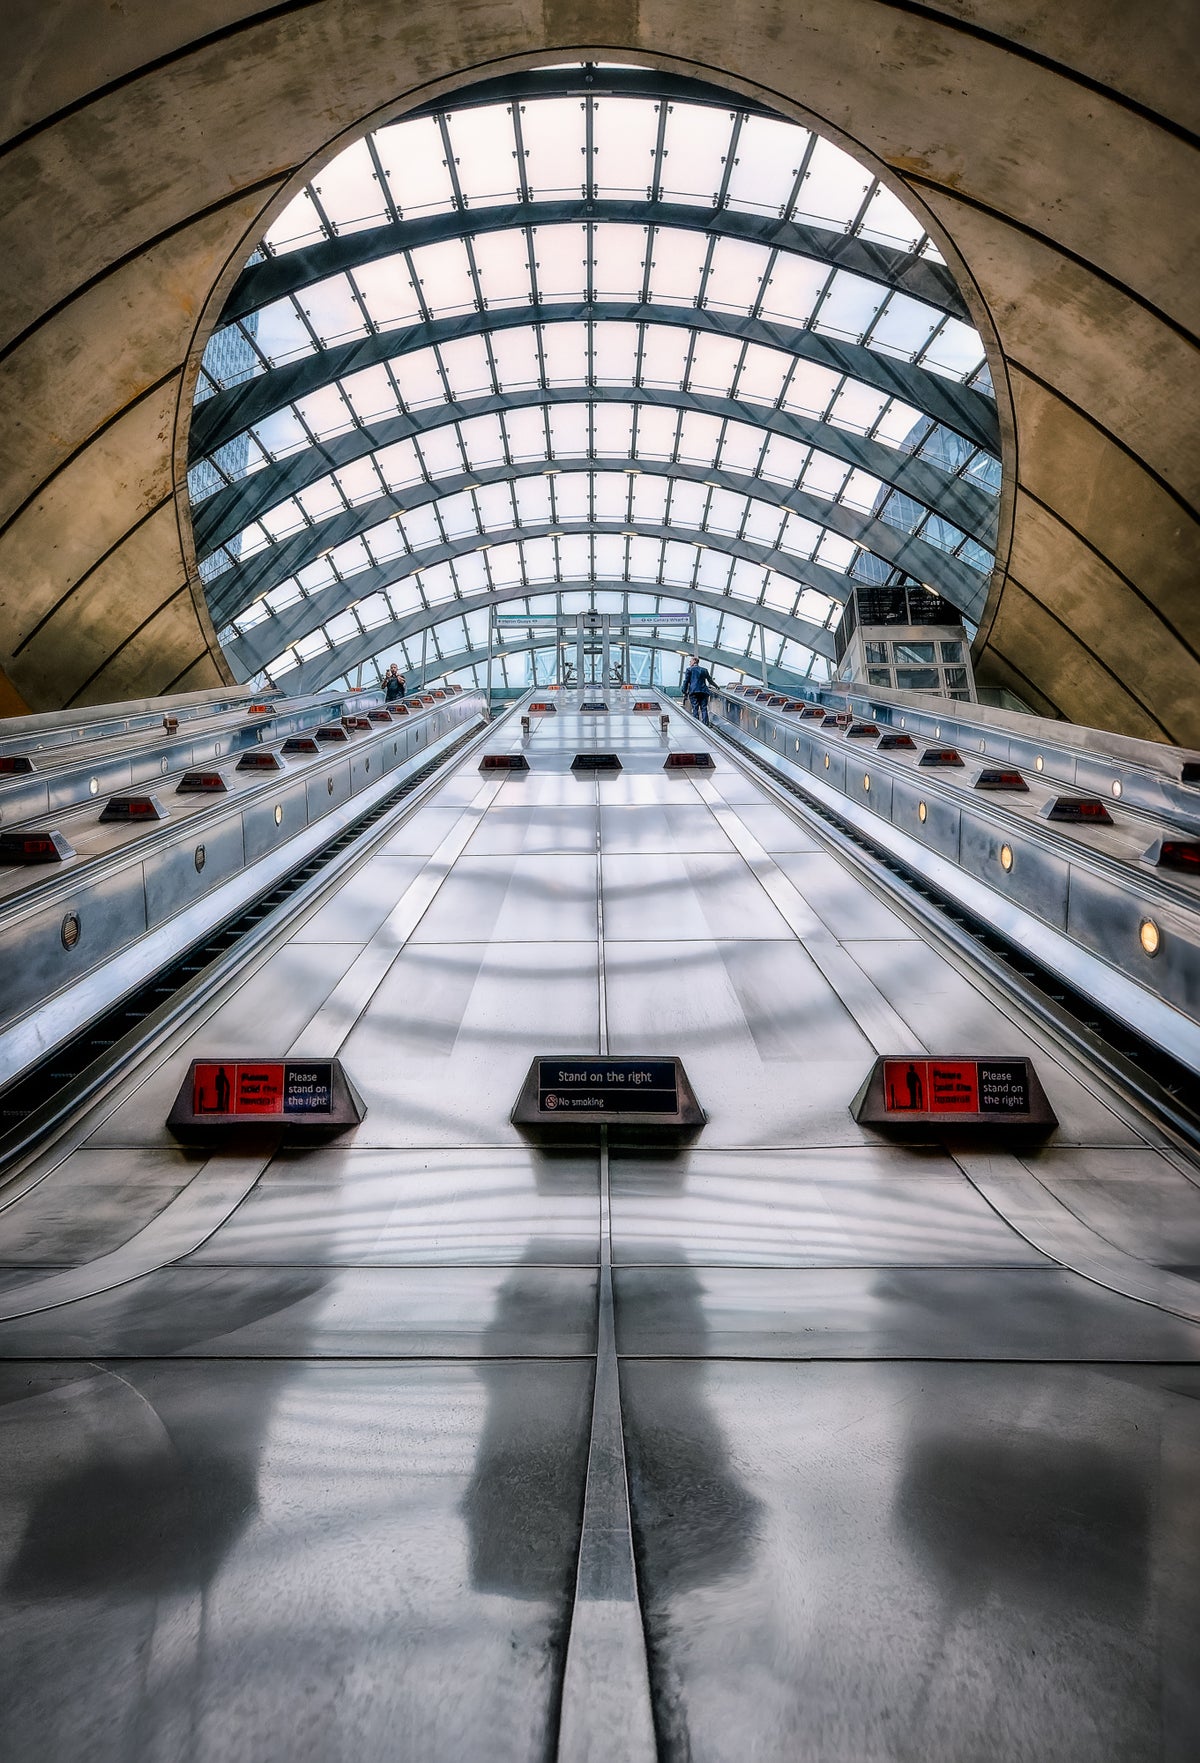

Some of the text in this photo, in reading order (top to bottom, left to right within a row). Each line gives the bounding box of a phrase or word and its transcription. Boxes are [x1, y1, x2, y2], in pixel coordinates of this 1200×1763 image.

[288, 1072, 318, 1082] Please
[558, 1071, 652, 1084] Stand on the right
[982, 1071, 1012, 1081] Please
[288, 1085, 327, 1094] stand on
[983, 1084, 1023, 1093] stand on
[288, 1096, 328, 1107] the right
[558, 1097, 604, 1108] No smoking
[983, 1095, 1000, 1105] the
[1001, 1096, 1023, 1107] right
